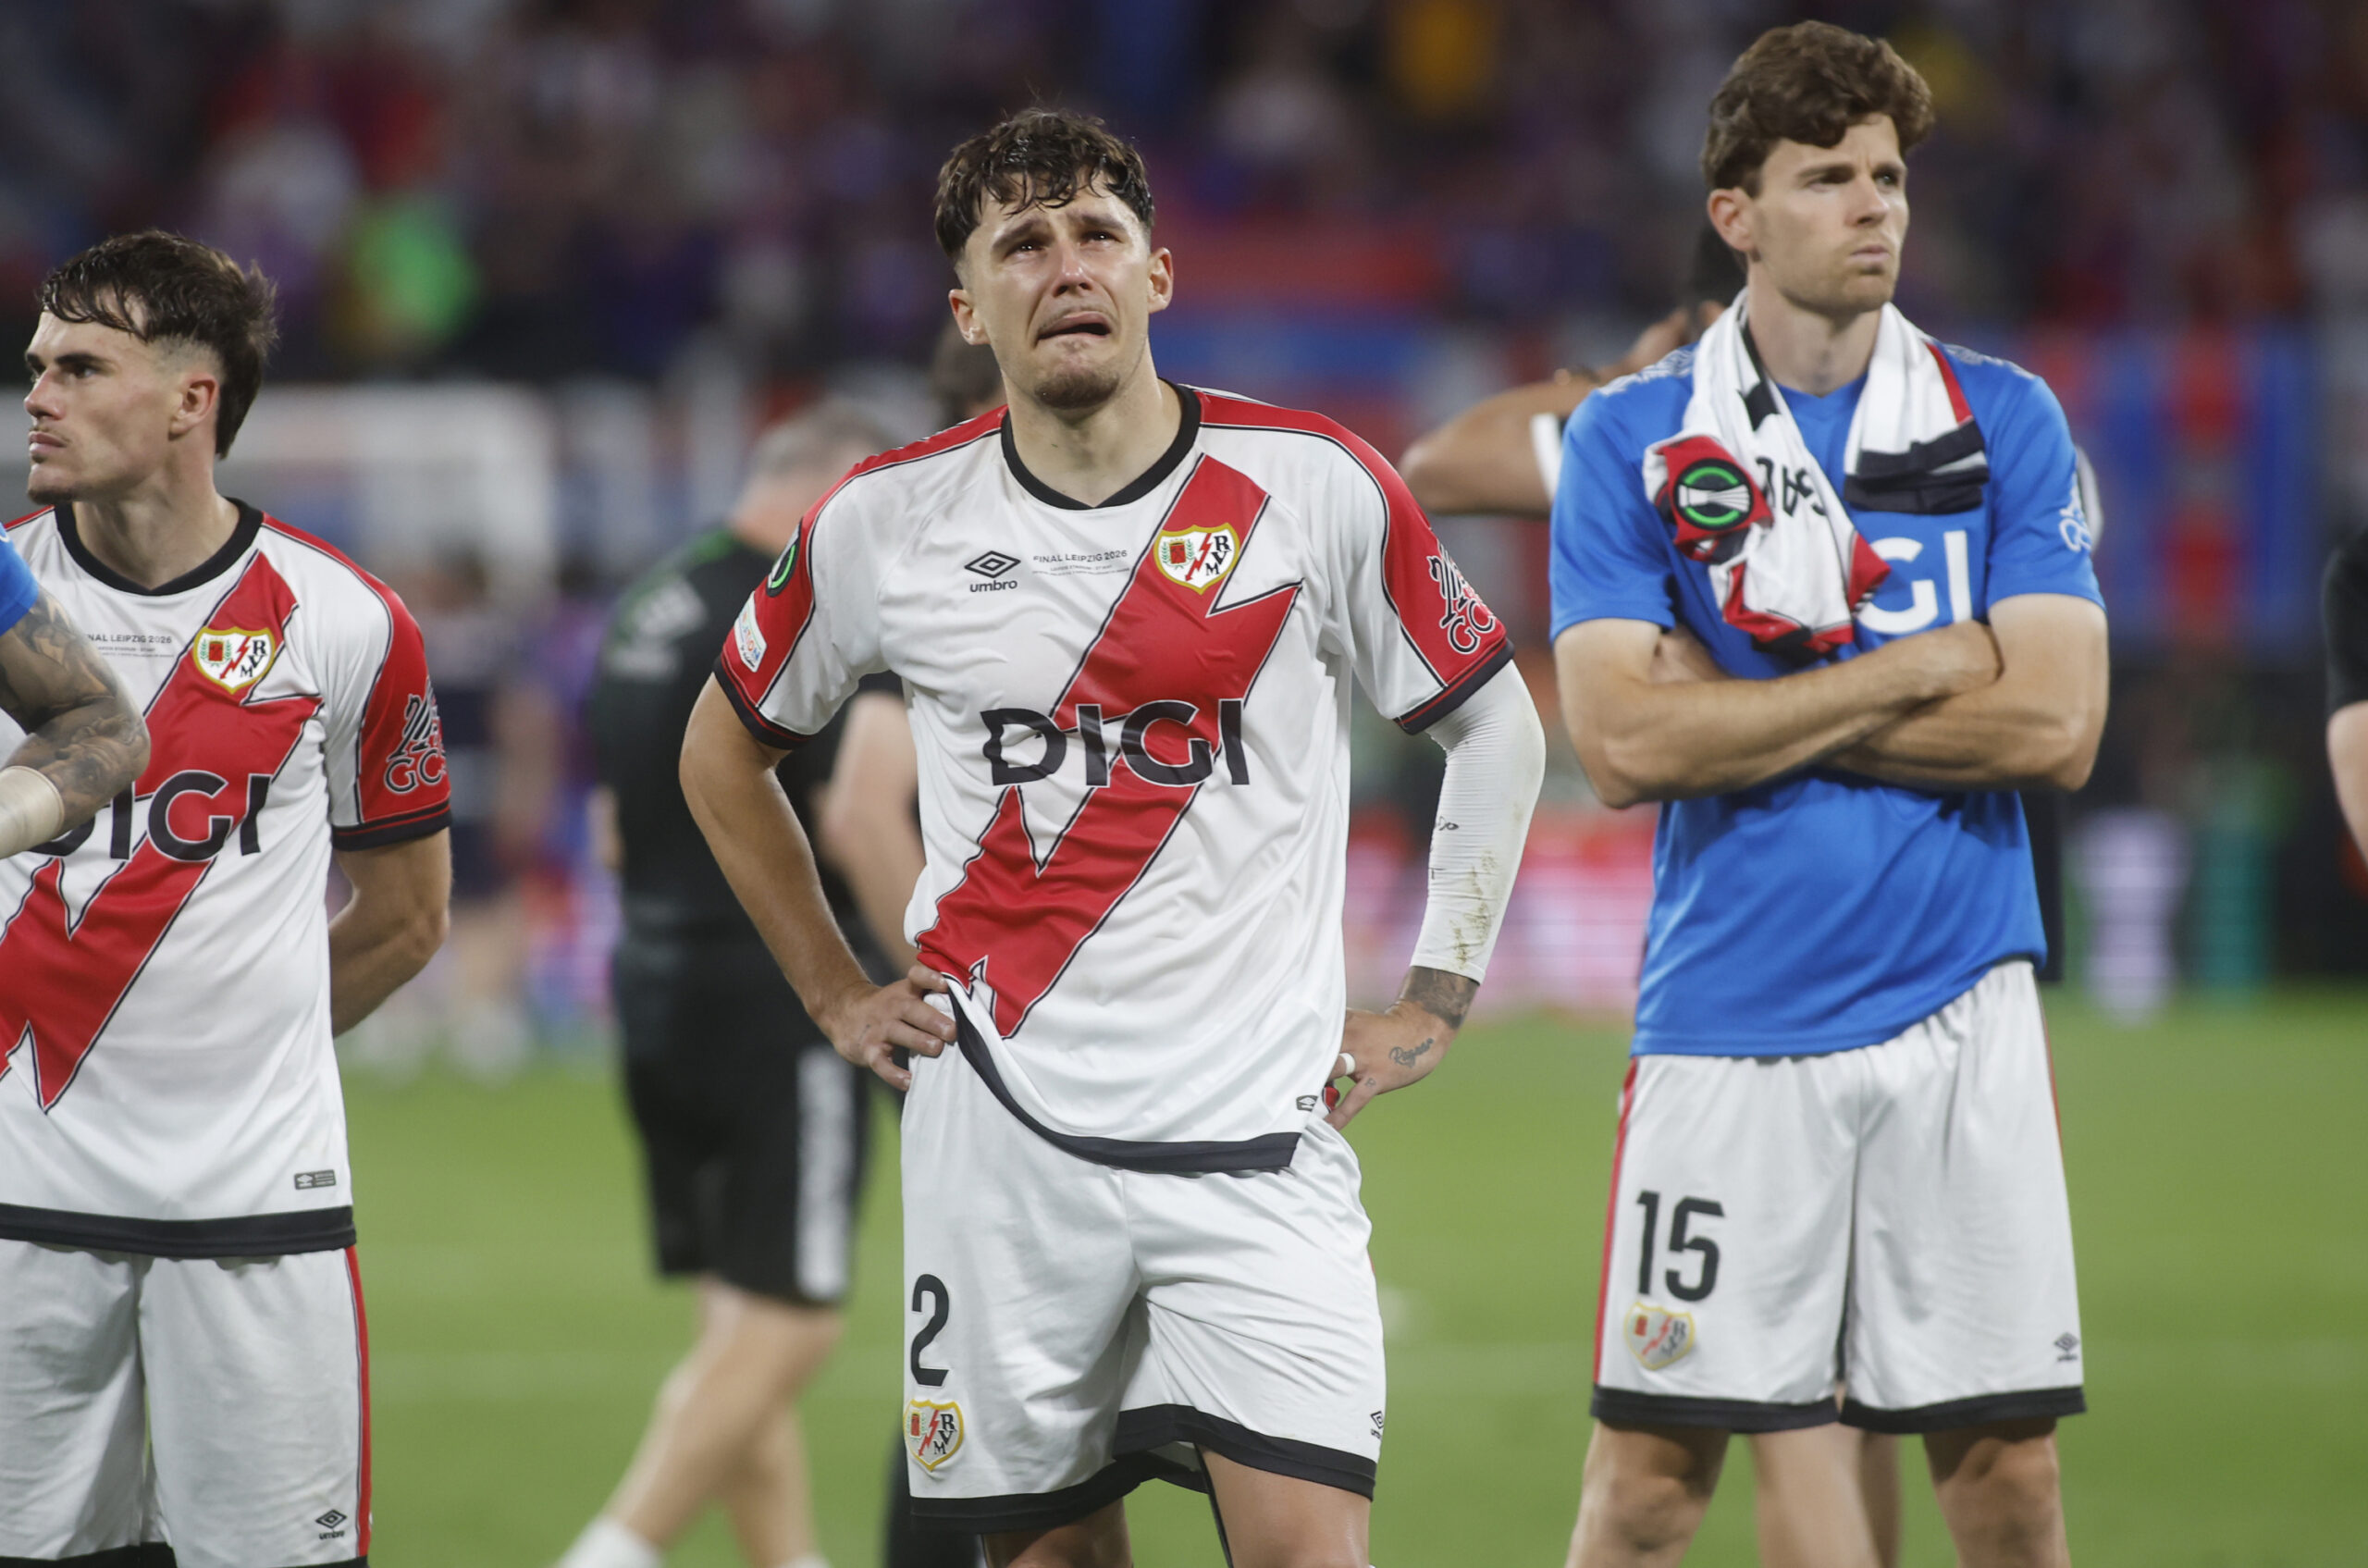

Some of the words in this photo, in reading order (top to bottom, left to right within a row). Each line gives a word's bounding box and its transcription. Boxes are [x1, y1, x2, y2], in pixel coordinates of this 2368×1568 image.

[969, 580, 1018, 592] umbro
[1065, 553, 1103, 562] LEIPZIG
[1104, 550, 1128, 561] 2026
[1857, 530, 1973, 635] GI
[87, 634, 107, 642] NAL
[110, 635, 146, 643] LEIPZIG
[148, 636, 172, 644] 2026
[980, 699, 1251, 786] DIGI
[1636, 1189, 1725, 1303] 15
[910, 1273, 950, 1387] 2
